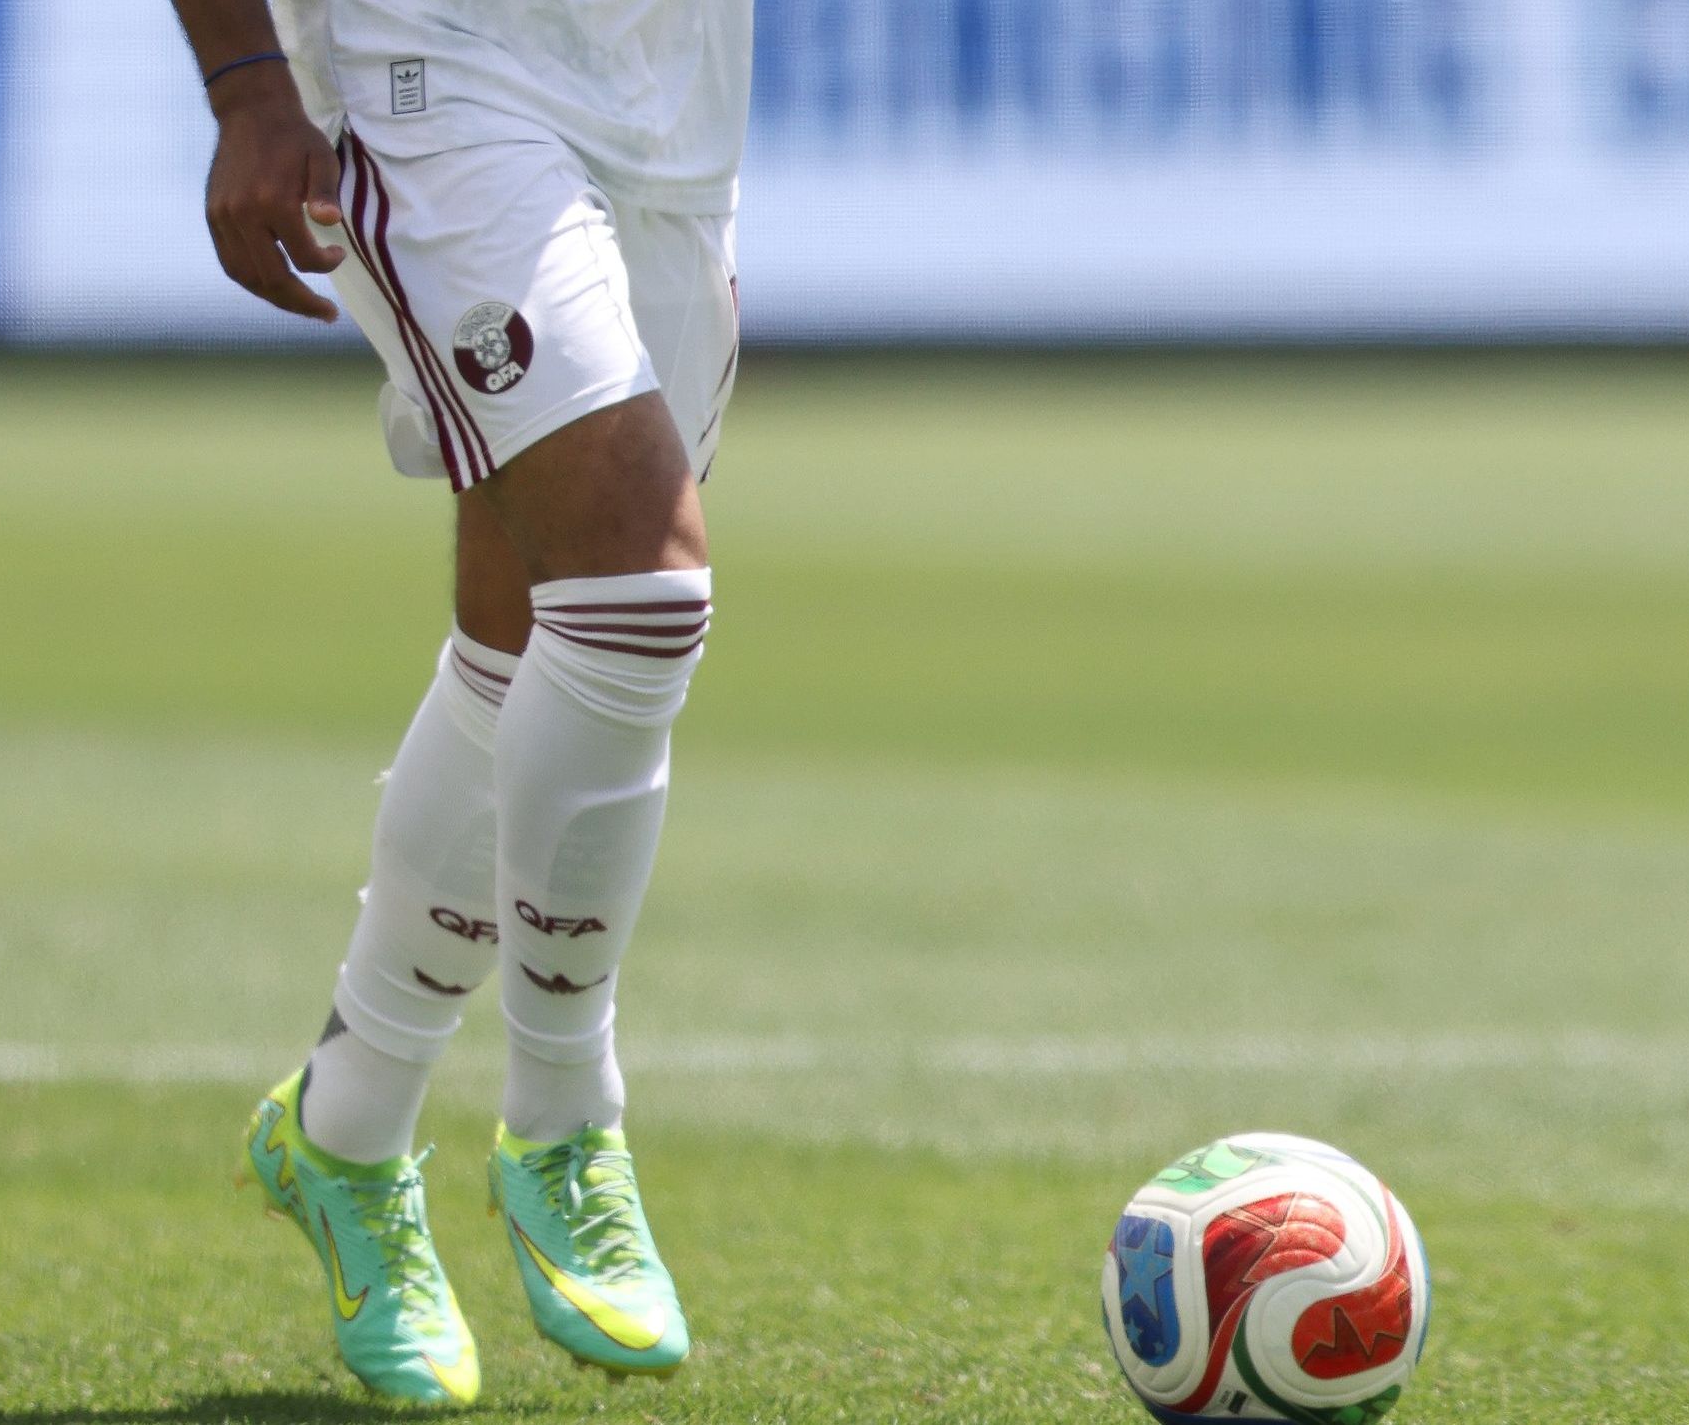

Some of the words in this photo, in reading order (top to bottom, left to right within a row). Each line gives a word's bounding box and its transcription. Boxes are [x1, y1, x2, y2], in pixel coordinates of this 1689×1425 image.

[485, 360, 525, 392] QFA
[429, 906, 498, 944] QF
[514, 899, 608, 938] QFA
